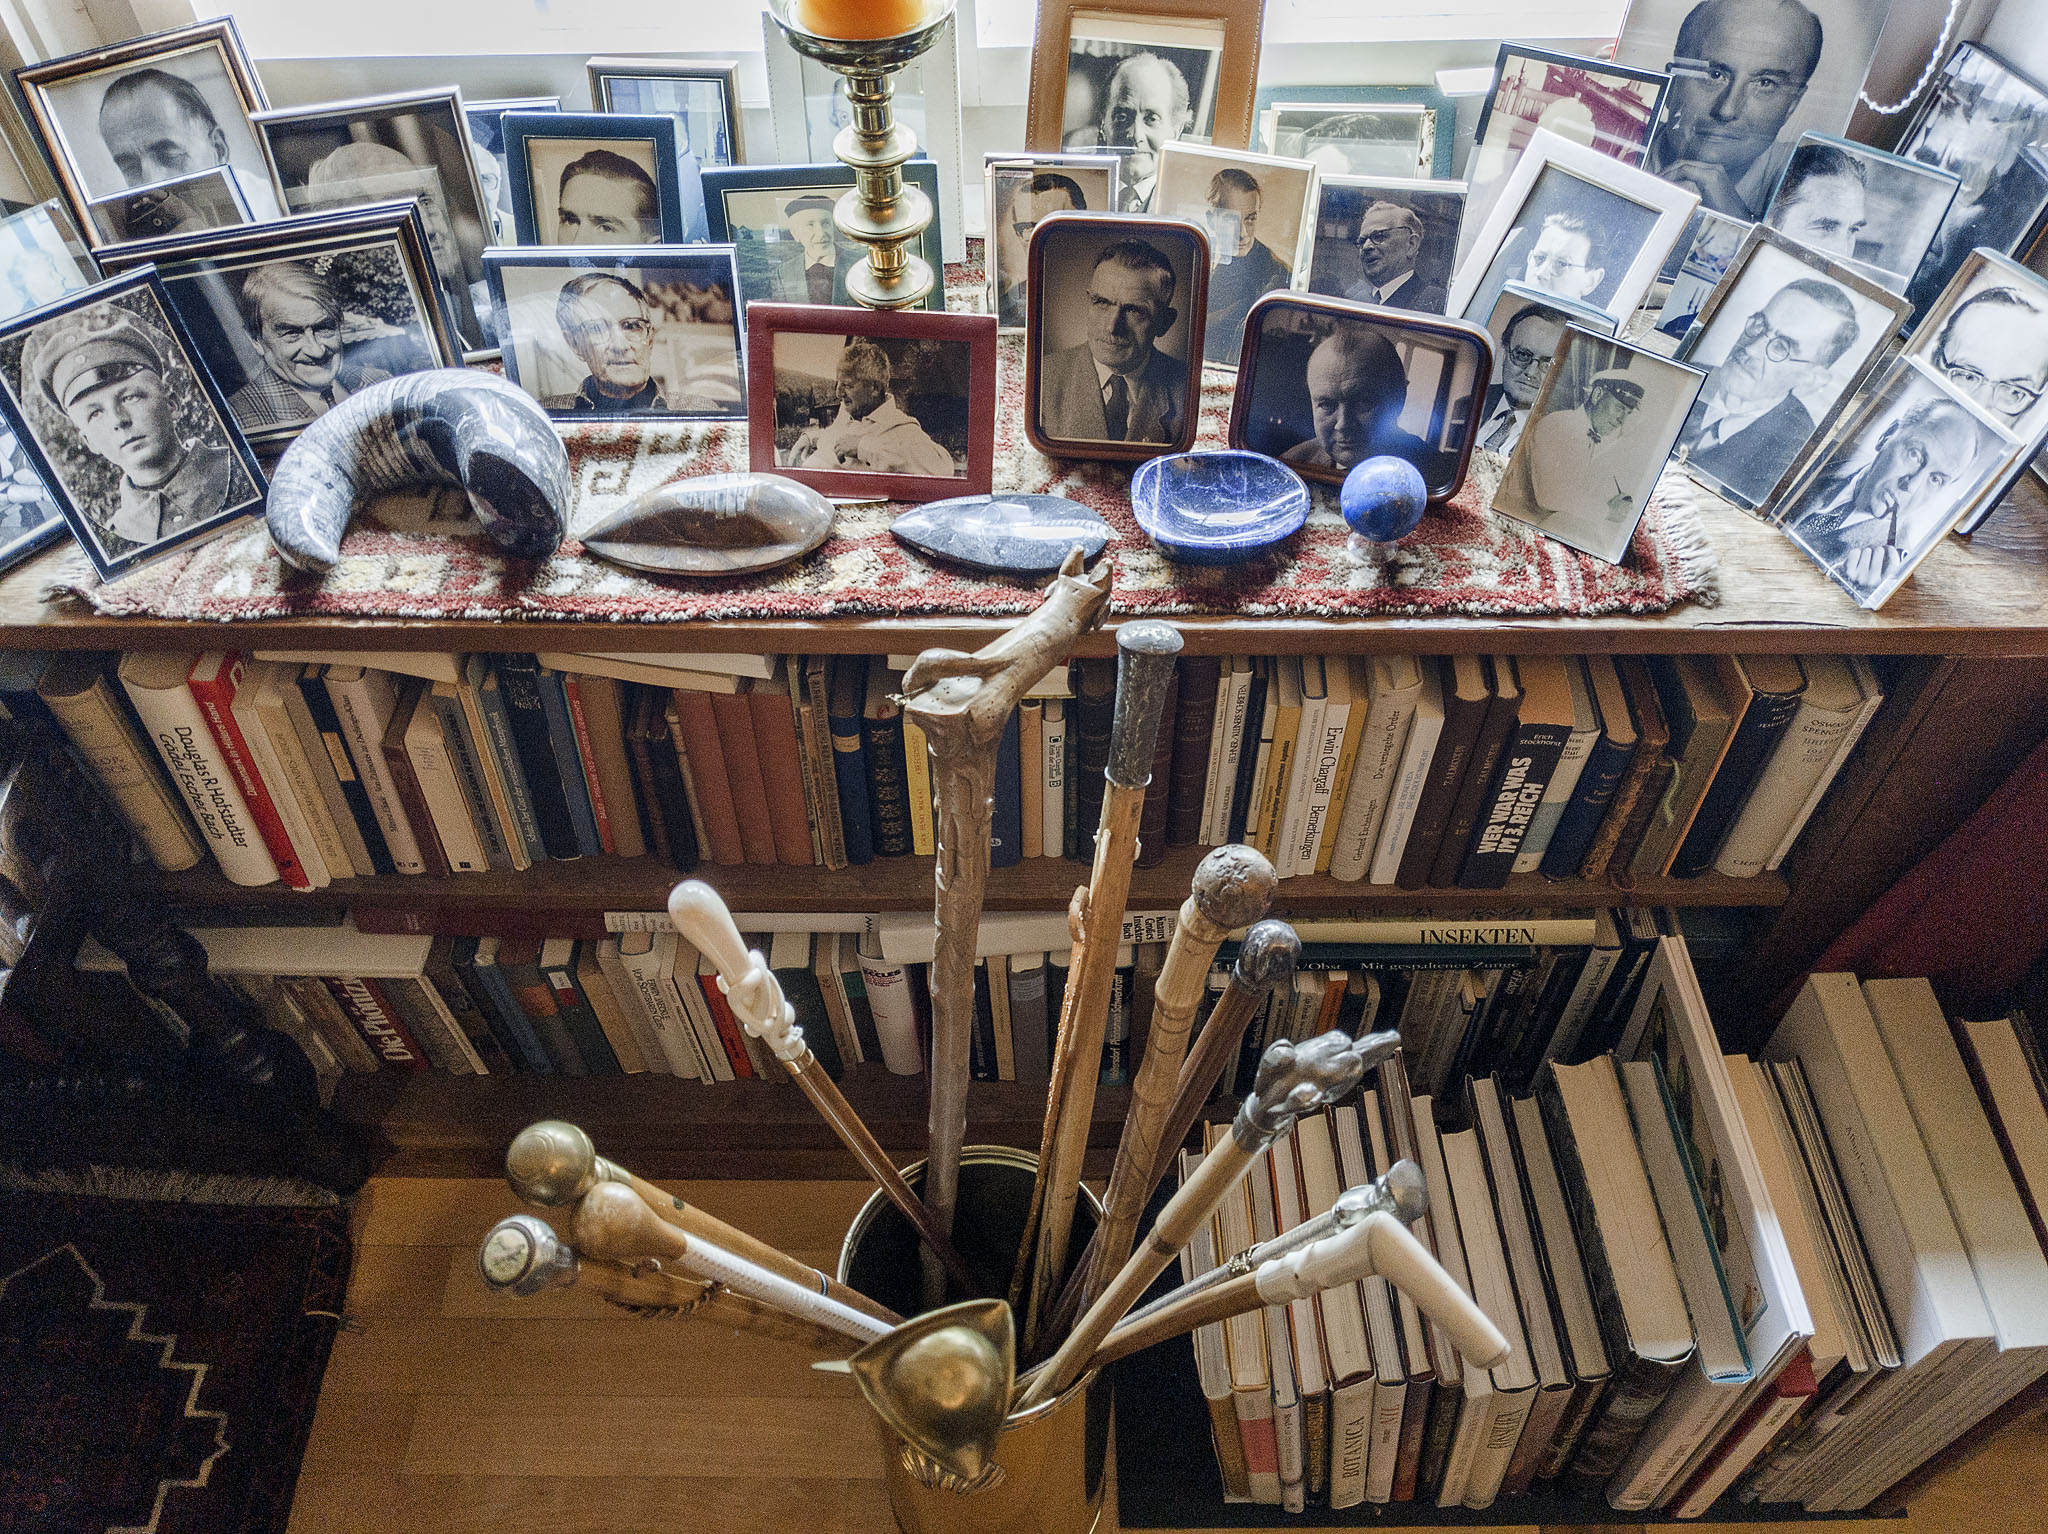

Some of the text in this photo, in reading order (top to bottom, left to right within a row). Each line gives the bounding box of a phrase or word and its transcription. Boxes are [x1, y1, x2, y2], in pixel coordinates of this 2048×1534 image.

[203, 701, 222, 722] Hand
[1323, 727, 1343, 755] Erwin
[1519, 739, 1562, 747] Stockhorst
[160, 733, 225, 839] Gödel Escher Bach
[1313, 756, 1336, 795] Chargaff
[1374, 767, 1385, 779] Die
[174, 726, 210, 777] Douglas
[207, 787, 248, 848] Hofstadter
[1477, 757, 1532, 854] WER WAR WAS
[1299, 805, 1326, 860] Bemerkungen
[1497, 838, 1520, 854] IM
[1122, 922, 1133, 940] Buch
[1133, 915, 1143, 943] Insekten
[1155, 916, 1166, 940] Knaurs
[1420, 928, 1536, 945] INSEKTEN
[1361, 962, 1384, 970] Mit
[1389, 962, 1468, 971] gespaltener
[1473, 961, 1520, 970] Zunge
[1113, 974, 1123, 1013] Schwerkraft
[376, 1035, 414, 1060] Die
[1342, 1416, 1365, 1480] BOTANICA
